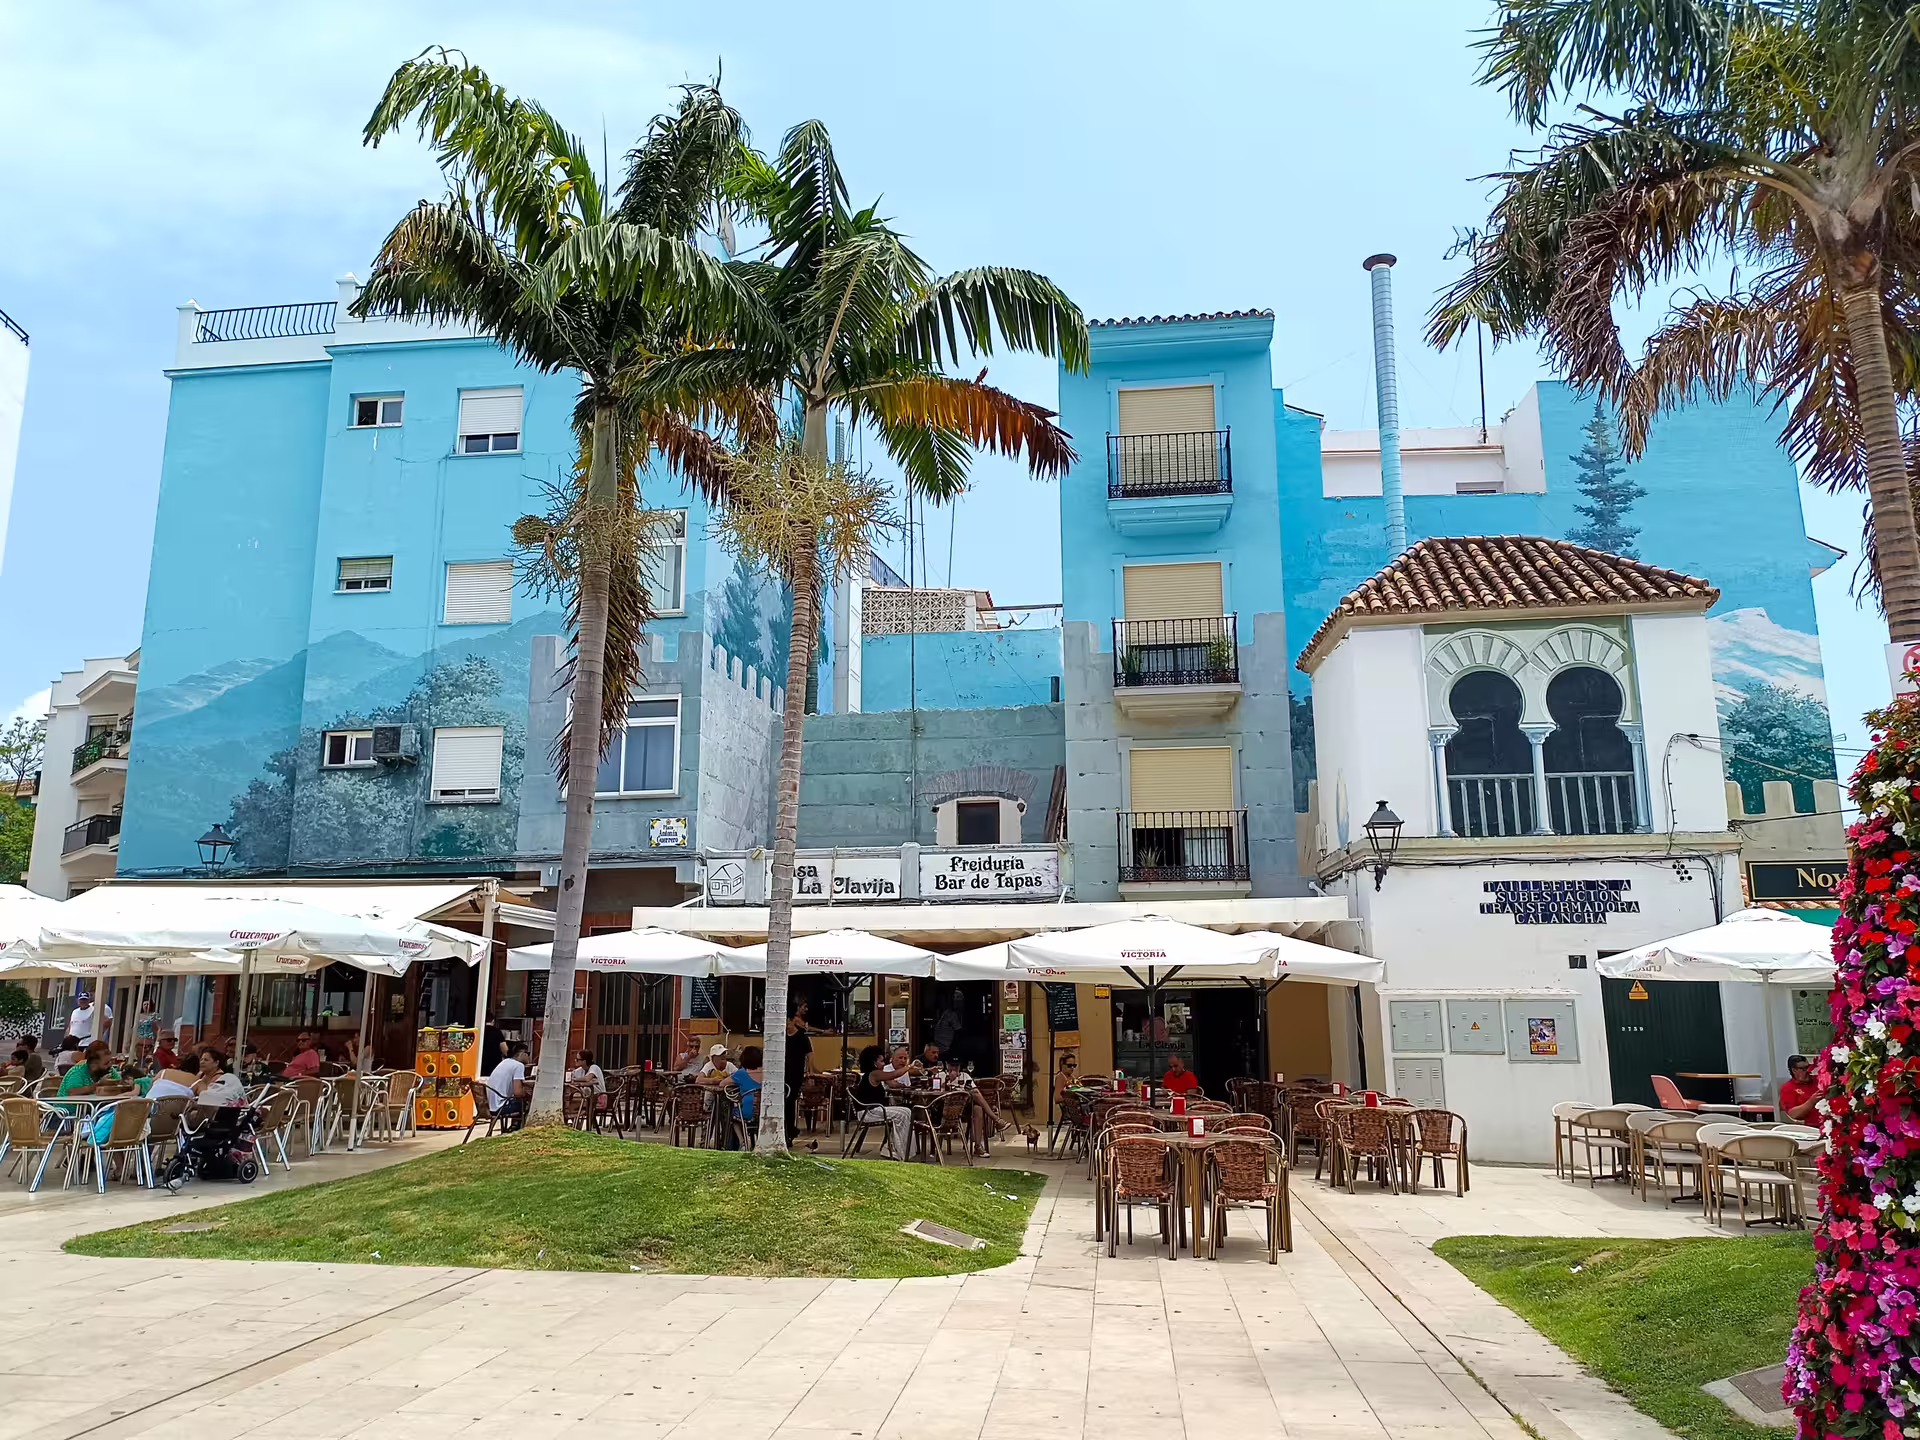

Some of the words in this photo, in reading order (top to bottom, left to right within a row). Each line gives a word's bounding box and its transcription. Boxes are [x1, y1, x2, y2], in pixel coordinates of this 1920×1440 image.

[950, 855, 1025, 871] Freiduría
[797, 878, 822, 894] La
[833, 877, 895, 897] Clavija
[935, 875, 965, 890] Bar
[971, 874, 989, 888] de
[995, 873, 1042, 890] Tapas
[1484, 881, 1586, 892] TAILLEFER
[1598, 880, 1607, 890] S
[1621, 880, 1631, 890] A
[1497, 891, 1621, 902] SUBESTACION
[1481, 902, 1640, 914] TRANSFORMADORA
[1516, 913, 1606, 924] CALANCHA
[229, 929, 280, 941] Cruzcampo
[1573, 956, 1580, 967] 7
